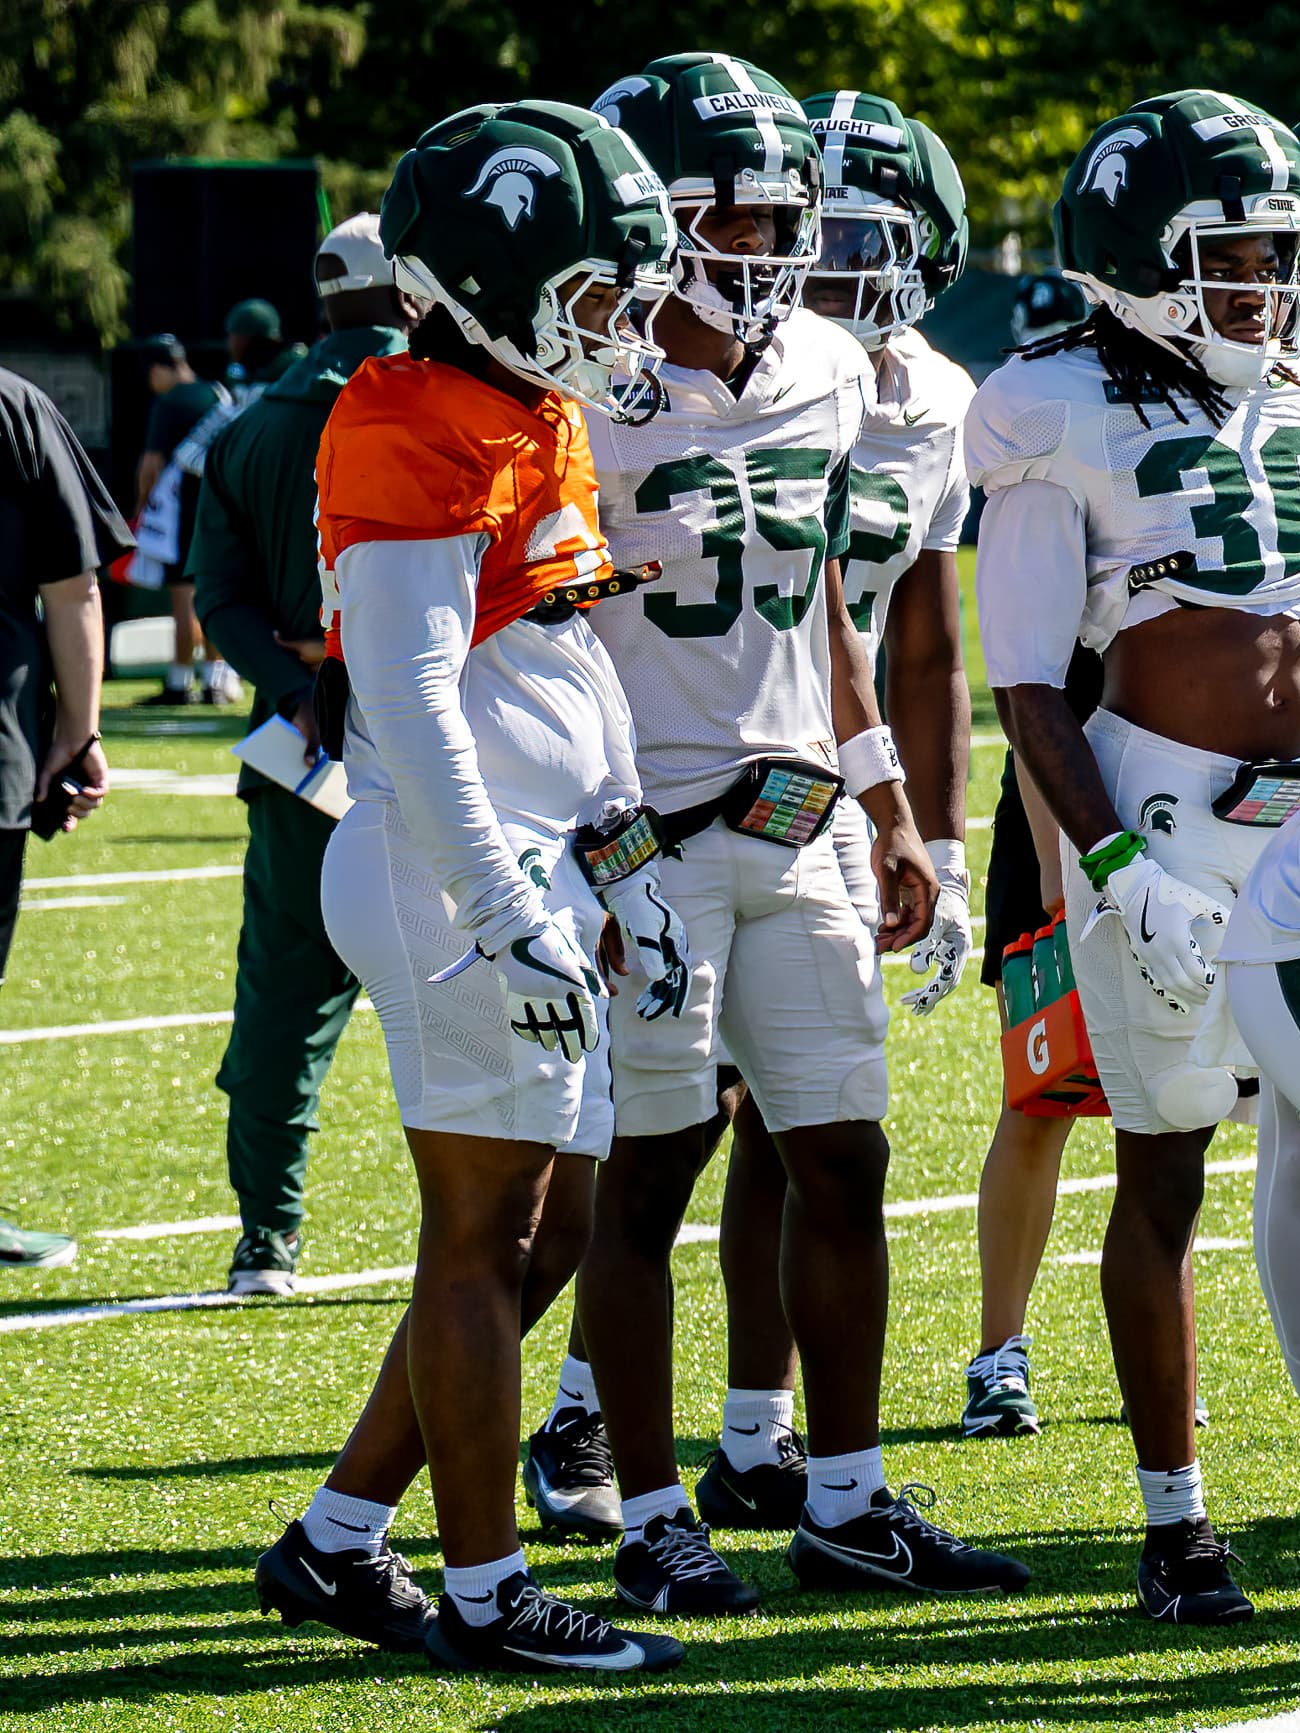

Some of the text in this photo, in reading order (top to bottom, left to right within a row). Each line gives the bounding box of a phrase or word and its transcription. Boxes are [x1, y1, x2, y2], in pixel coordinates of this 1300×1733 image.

[709, 94, 796, 113] CALDWELL
[635, 448, 832, 638] 35
[1026, 1018, 1050, 1075] G
